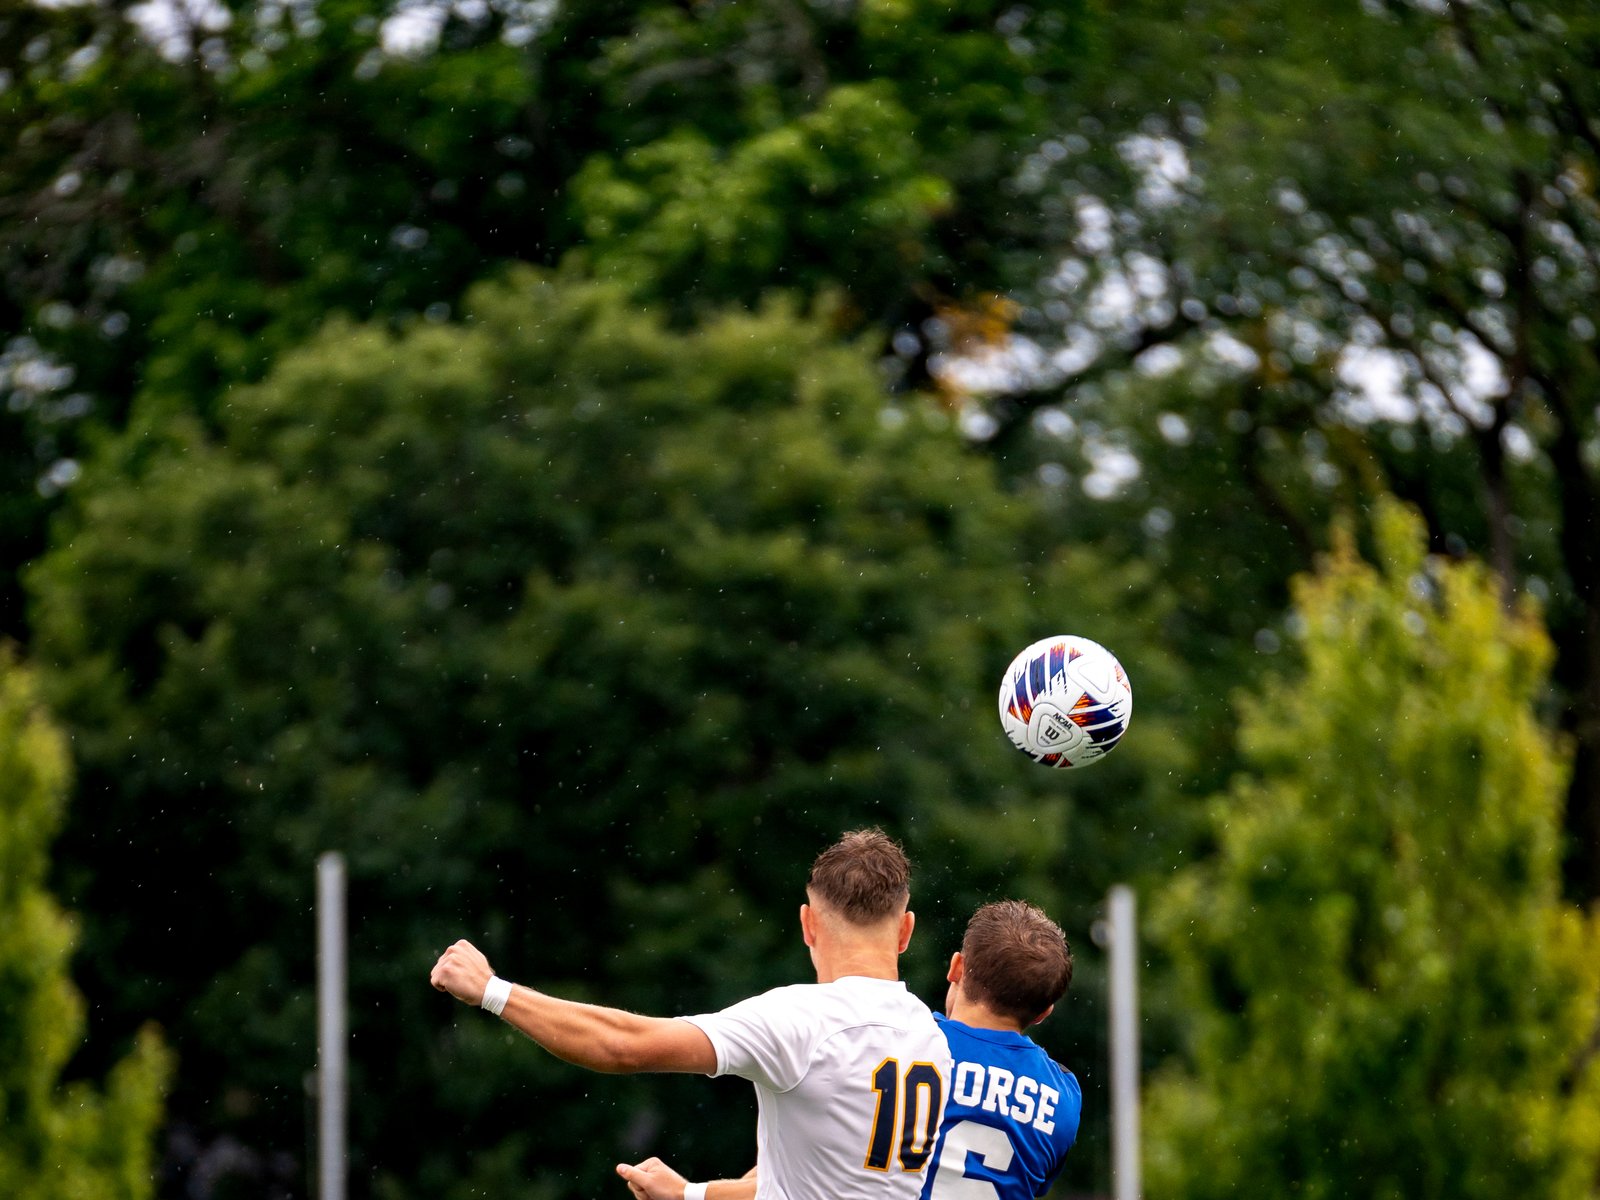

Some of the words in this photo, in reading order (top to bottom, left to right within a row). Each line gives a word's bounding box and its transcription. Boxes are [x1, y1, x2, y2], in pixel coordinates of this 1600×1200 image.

[1053, 712, 1073, 730] NCAA
[864, 1057, 942, 1172] 10
[951, 1059, 1060, 1135] ORSE
